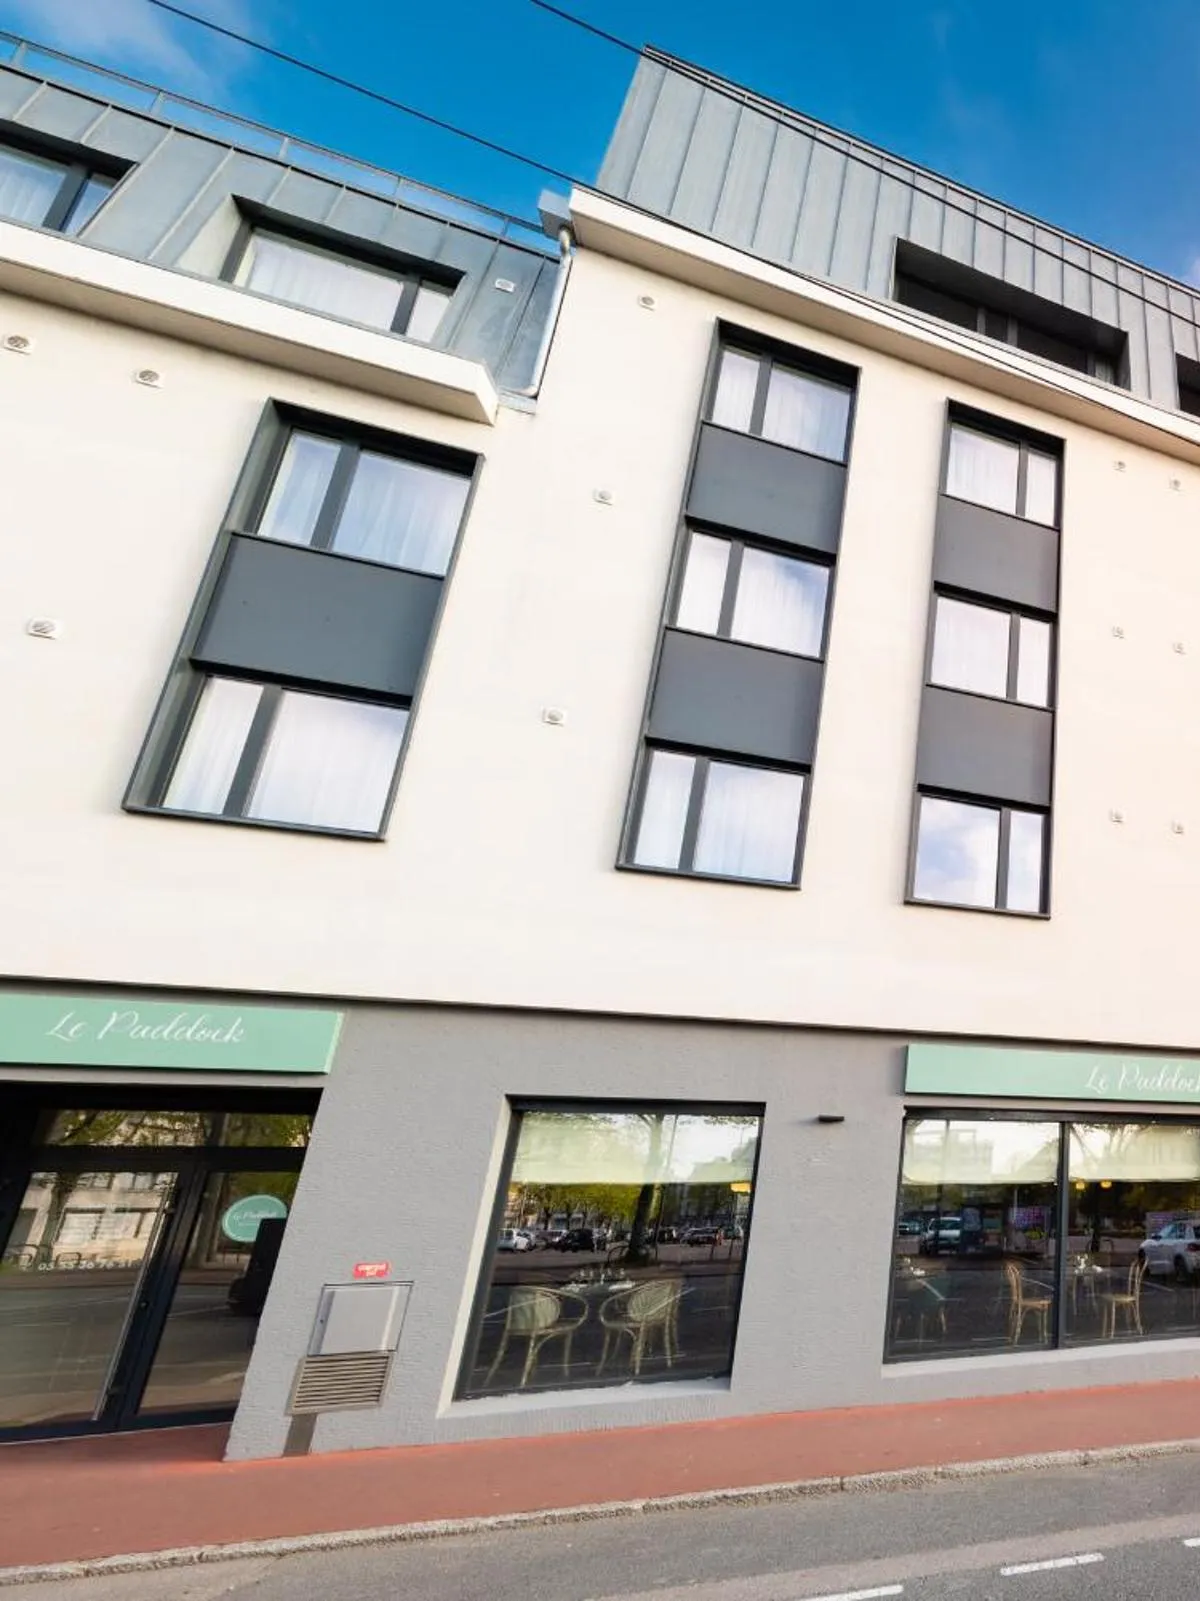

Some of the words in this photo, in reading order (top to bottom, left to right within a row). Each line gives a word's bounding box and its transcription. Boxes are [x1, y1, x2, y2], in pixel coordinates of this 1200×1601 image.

[46, 1011, 87, 1042] Le
[97, 1010, 247, 1043] Paddock
[1084, 1064, 1109, 1094] Le
